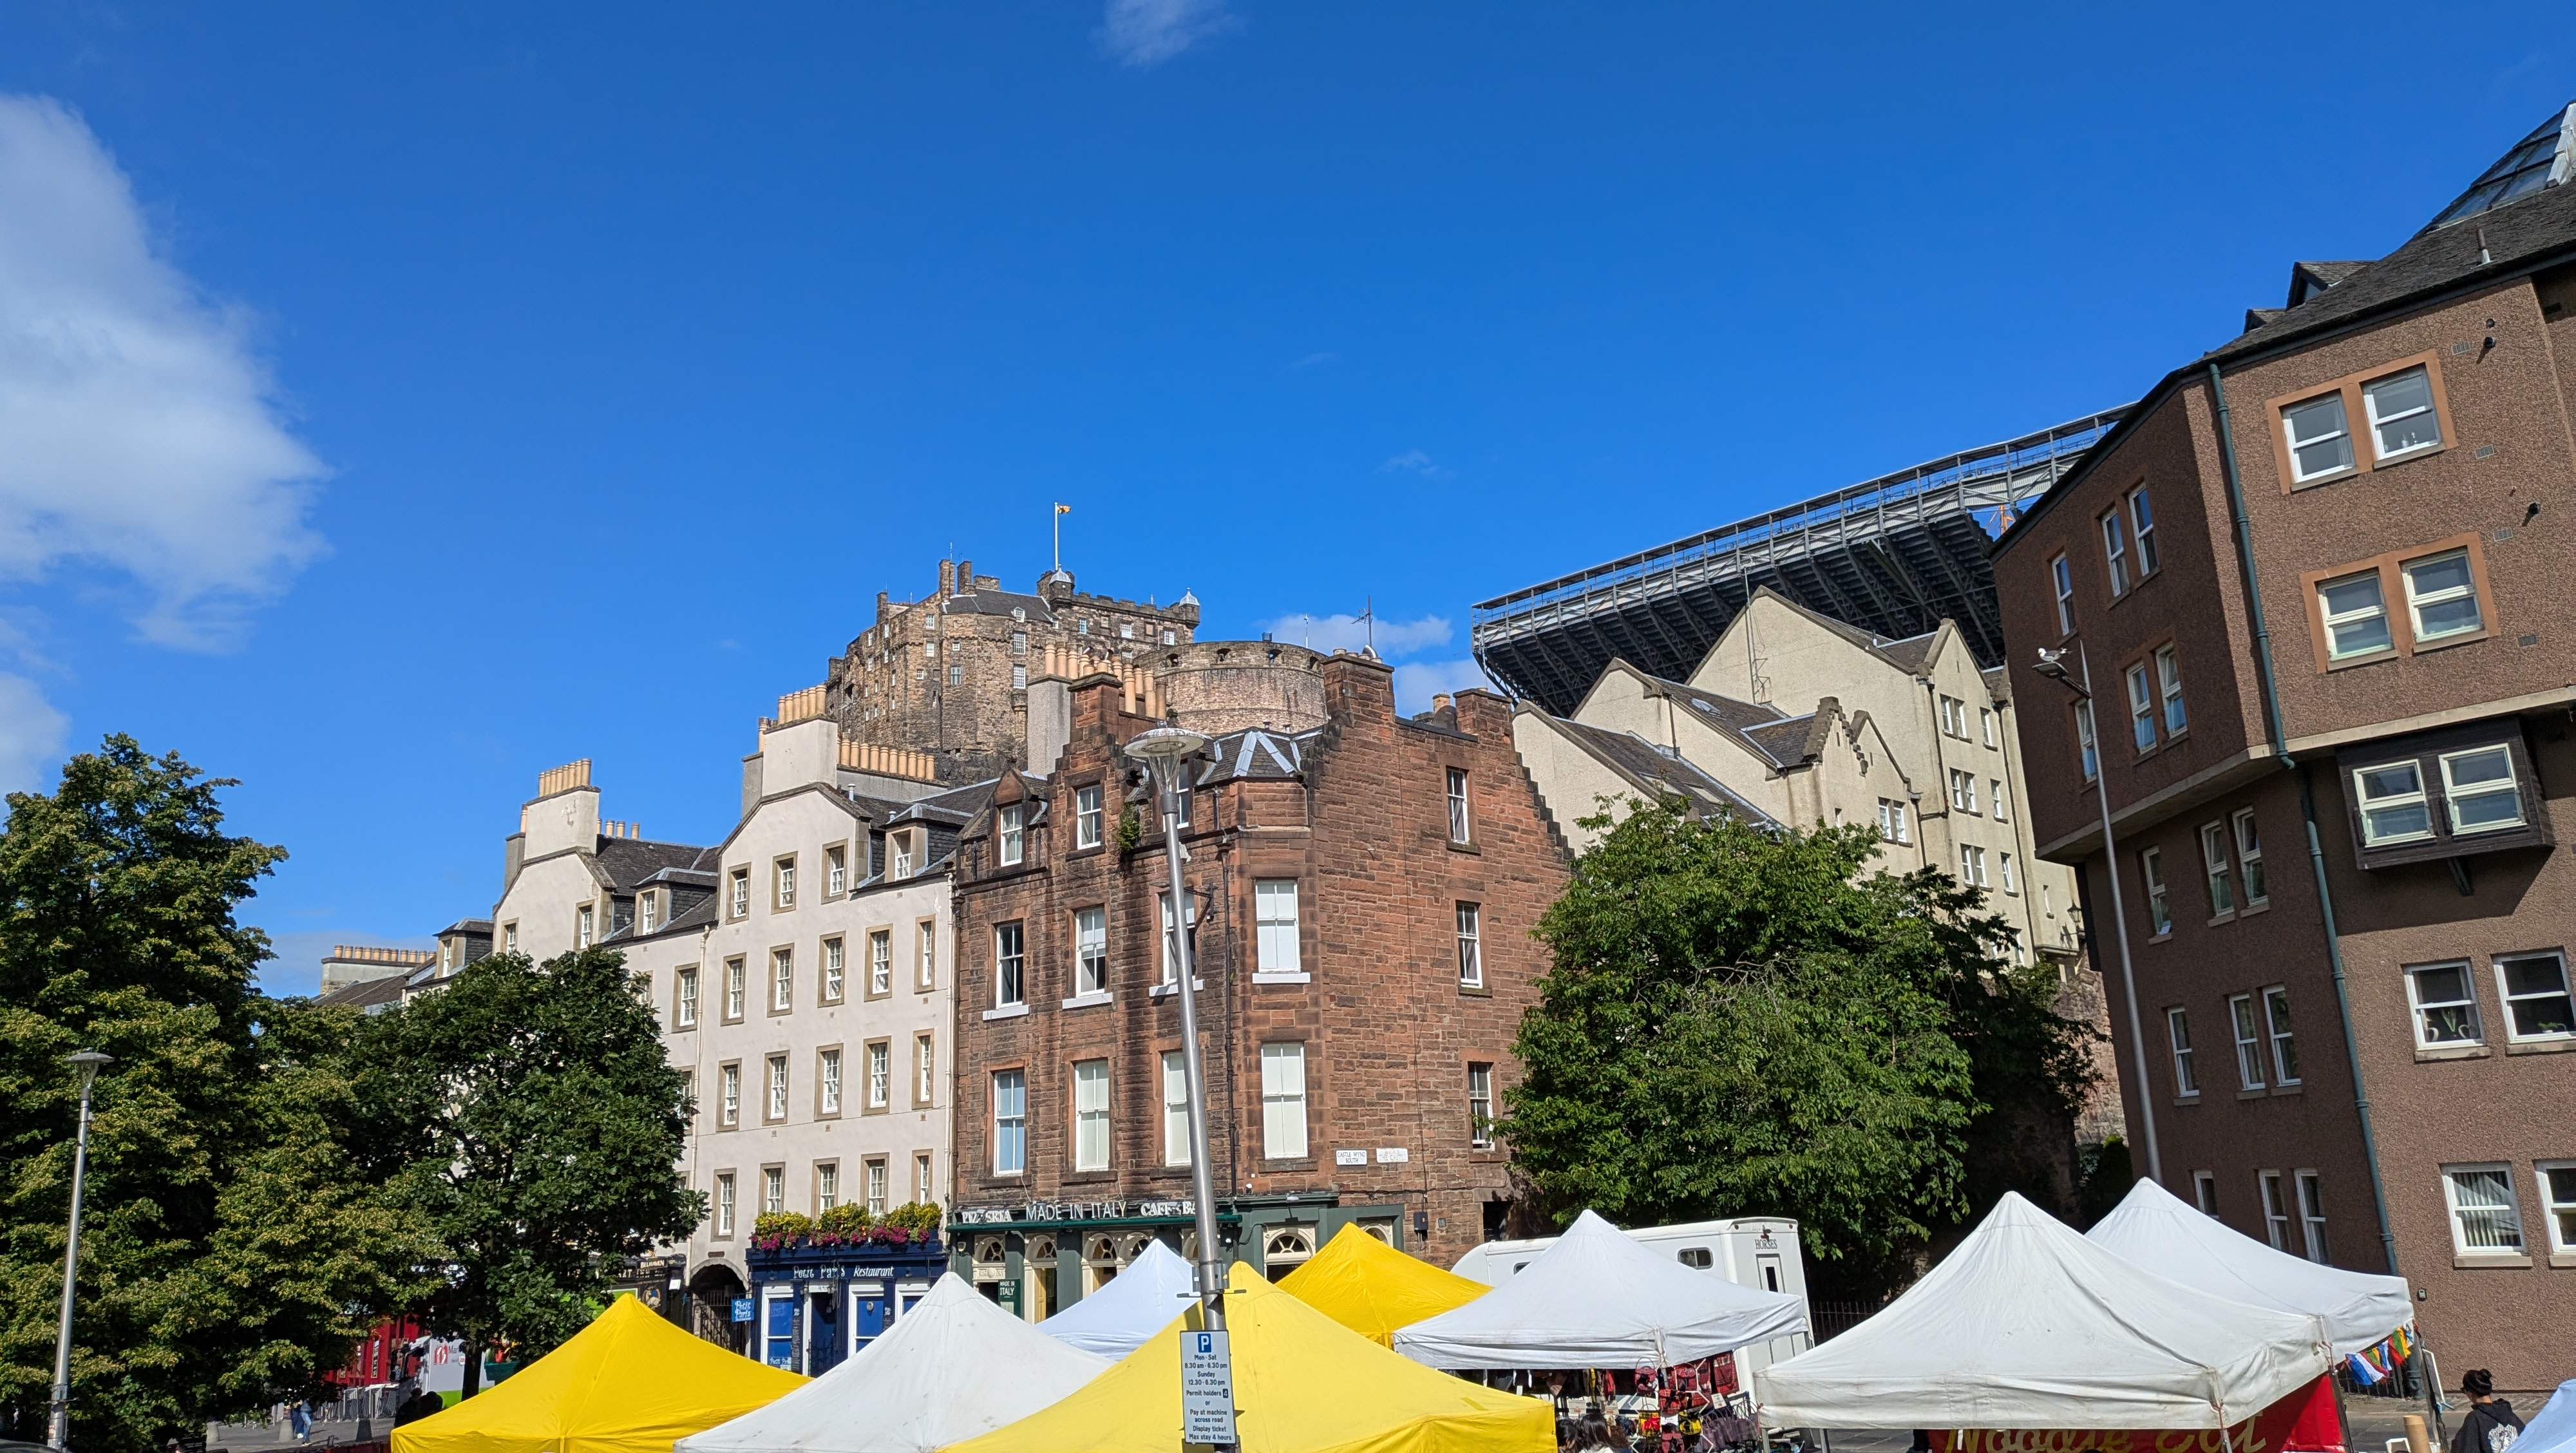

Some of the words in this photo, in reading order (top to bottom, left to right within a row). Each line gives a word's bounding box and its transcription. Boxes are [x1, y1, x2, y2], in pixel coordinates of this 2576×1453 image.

[1026, 1204, 1063, 1220] MADE
[1069, 1204, 1083, 1220] IN
[1091, 1201, 1126, 1219] ITALY
[961, 1209, 1012, 1224] PIZERIA
[1754, 1239, 1778, 1249] HORSES
[640, 1259, 665, 1269] BELHAVEN
[793, 1266, 815, 1279] Petit
[853, 1265, 895, 1277] Restaurant
[999, 1287, 1015, 1296] ITALY
[735, 1300, 752, 1309] Petit
[735, 1309, 751, 1319] Paris
[1200, 1335, 1209, 1351] P
